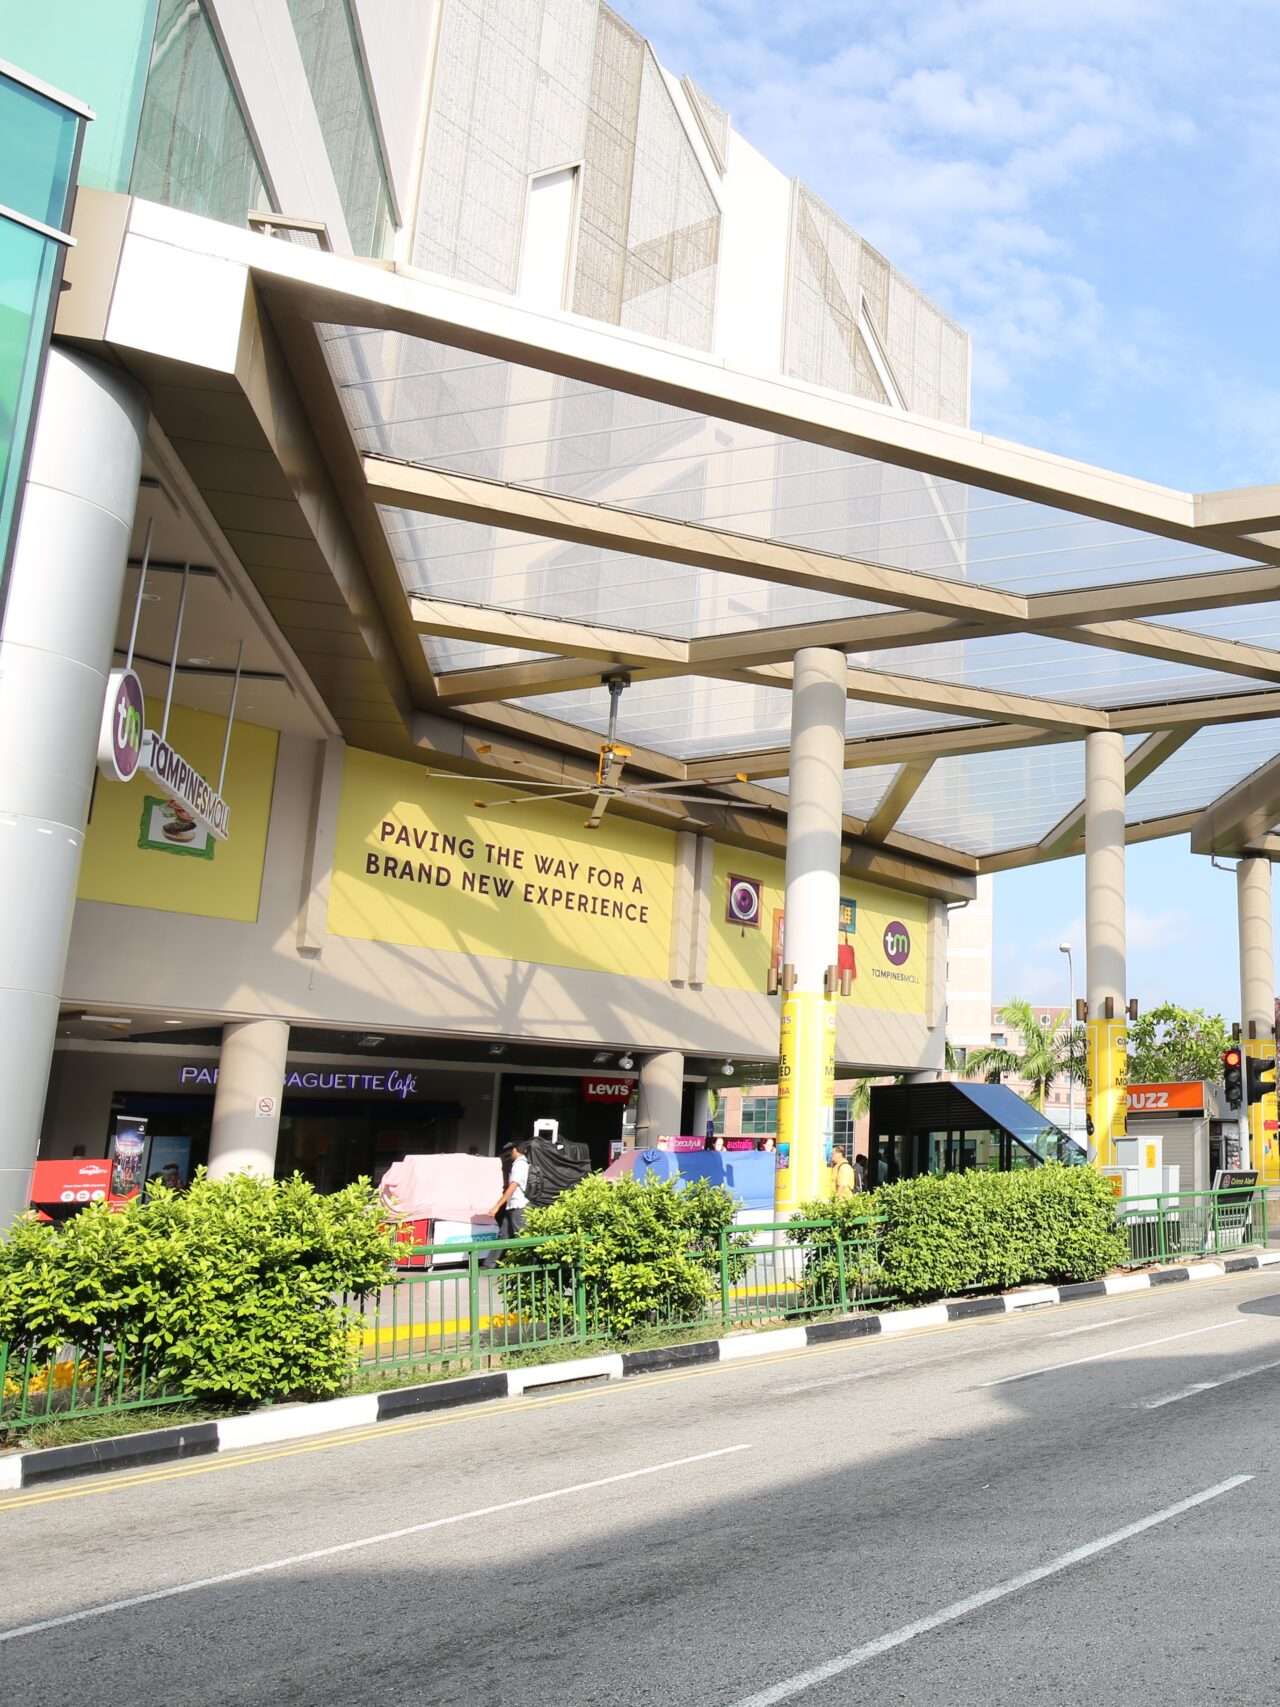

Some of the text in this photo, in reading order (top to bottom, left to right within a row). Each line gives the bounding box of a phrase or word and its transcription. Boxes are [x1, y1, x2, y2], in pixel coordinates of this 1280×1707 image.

[379, 821, 643, 894] PAVING THE WAY FOR A
[366, 852, 649, 924] BRAND NEW EXPERIENCE
[885, 931, 908, 956] tm
[284, 1072, 385, 1090] AGUETTE
[387, 1070, 417, 1099] Café
